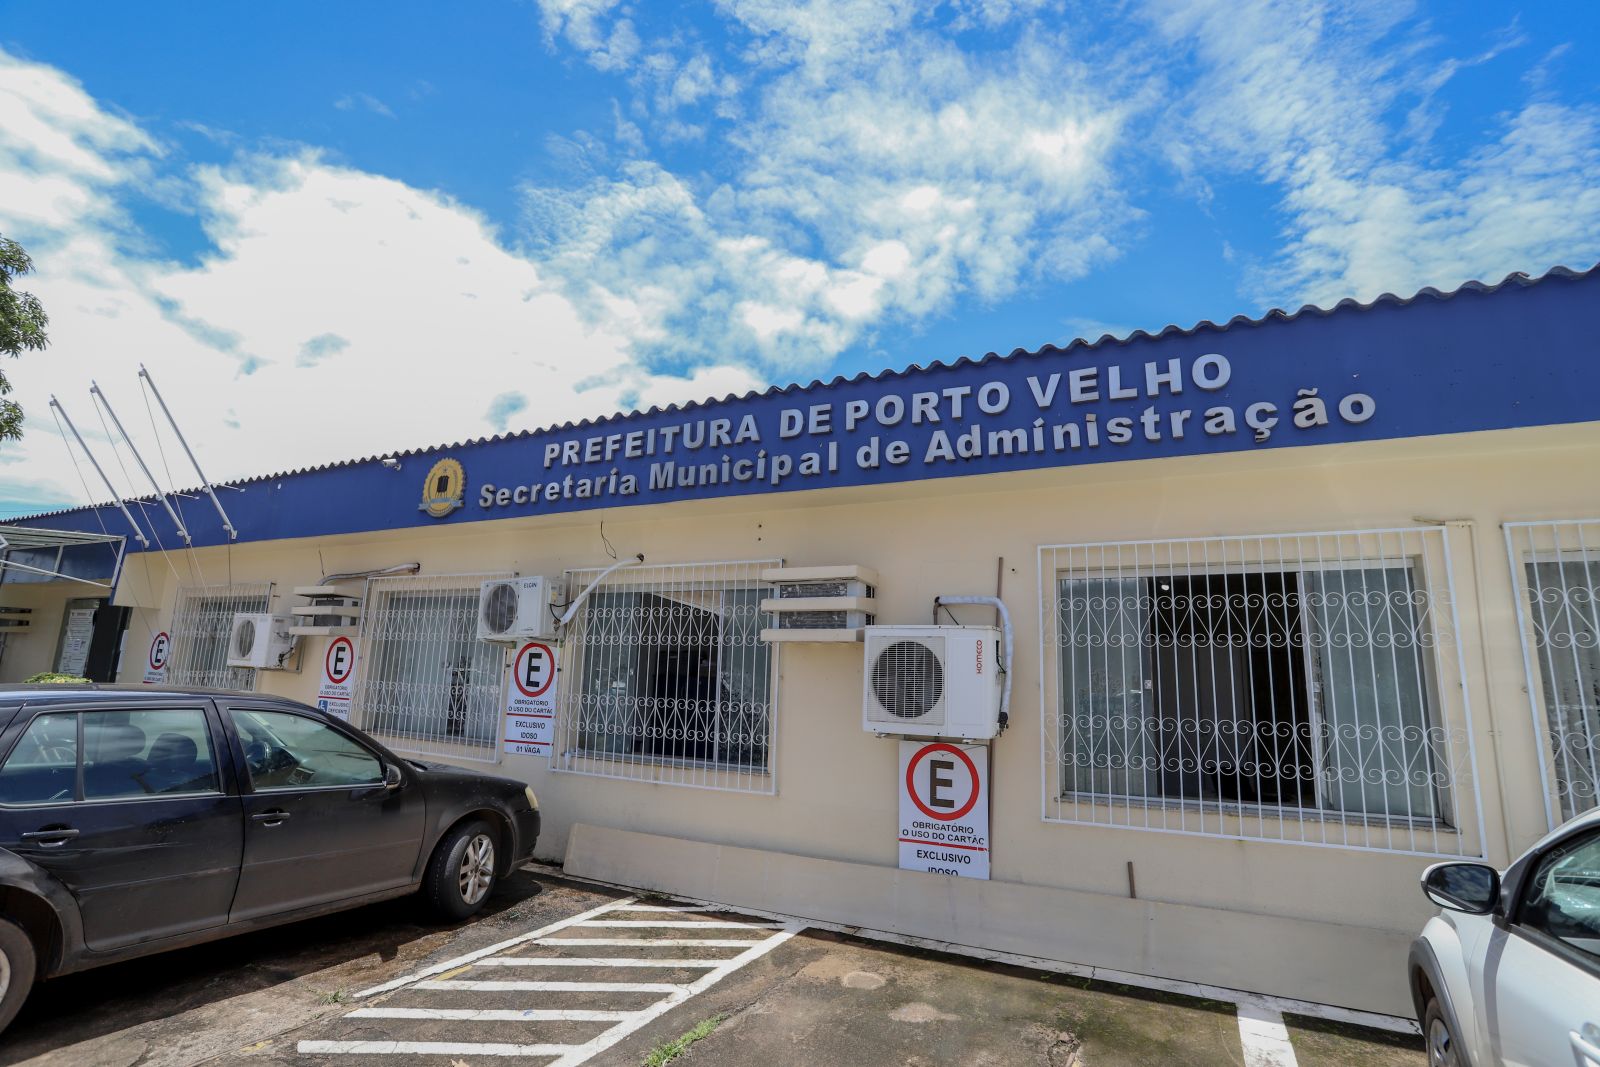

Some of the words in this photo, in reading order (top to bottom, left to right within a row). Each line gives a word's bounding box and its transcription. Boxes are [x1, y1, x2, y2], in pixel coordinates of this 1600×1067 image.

[543, 413, 760, 469] PREFEITURA
[779, 403, 832, 439] DE
[845, 381, 1010, 430] PORTO
[1026, 353, 1232, 408] VELHO
[479, 469, 639, 508] Secretaria
[648, 441, 837, 490] Municipal
[856, 436, 911, 469] de
[924, 387, 1376, 463] Administração
[154, 639, 165, 663] E
[333, 646, 346, 675] E
[525, 652, 543, 688] E
[515, 720, 546, 729] EXCLUSIVO
[524, 746, 541, 754] VAGA
[929, 759, 955, 808] E
[902, 828, 909, 836] O
[911, 830, 930, 838] USO
[932, 832, 945, 841] DO
[916, 849, 971, 864] EXCLUSIVO
